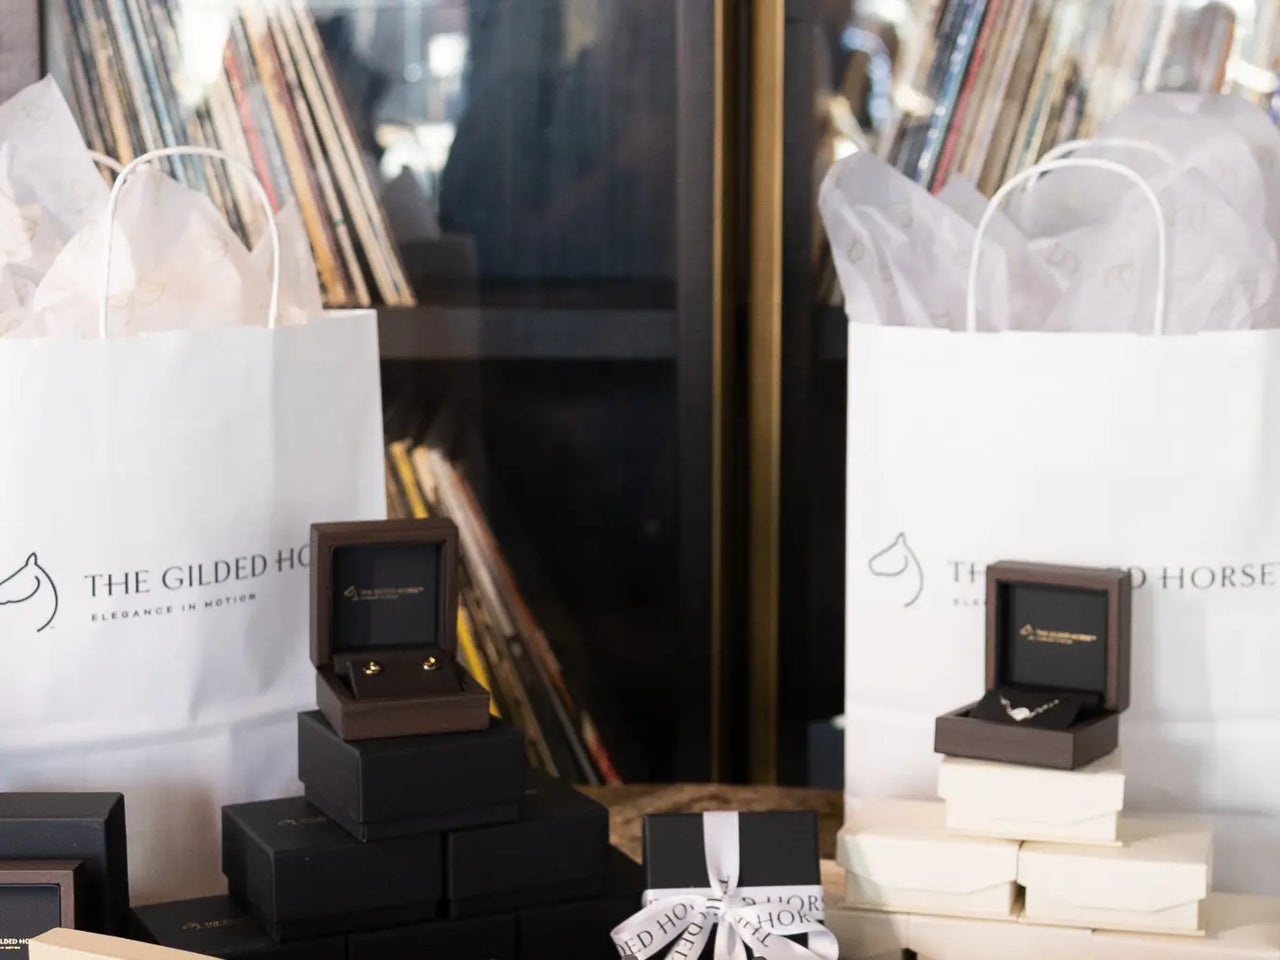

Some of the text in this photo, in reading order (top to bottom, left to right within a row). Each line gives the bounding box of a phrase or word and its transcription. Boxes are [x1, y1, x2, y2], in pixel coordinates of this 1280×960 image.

[84, 569, 151, 597] THE
[162, 553, 268, 592] GILDED
[1158, 563, 1278, 590] HORSE
[91, 592, 257, 622] ELEGANCE IN MOTION
